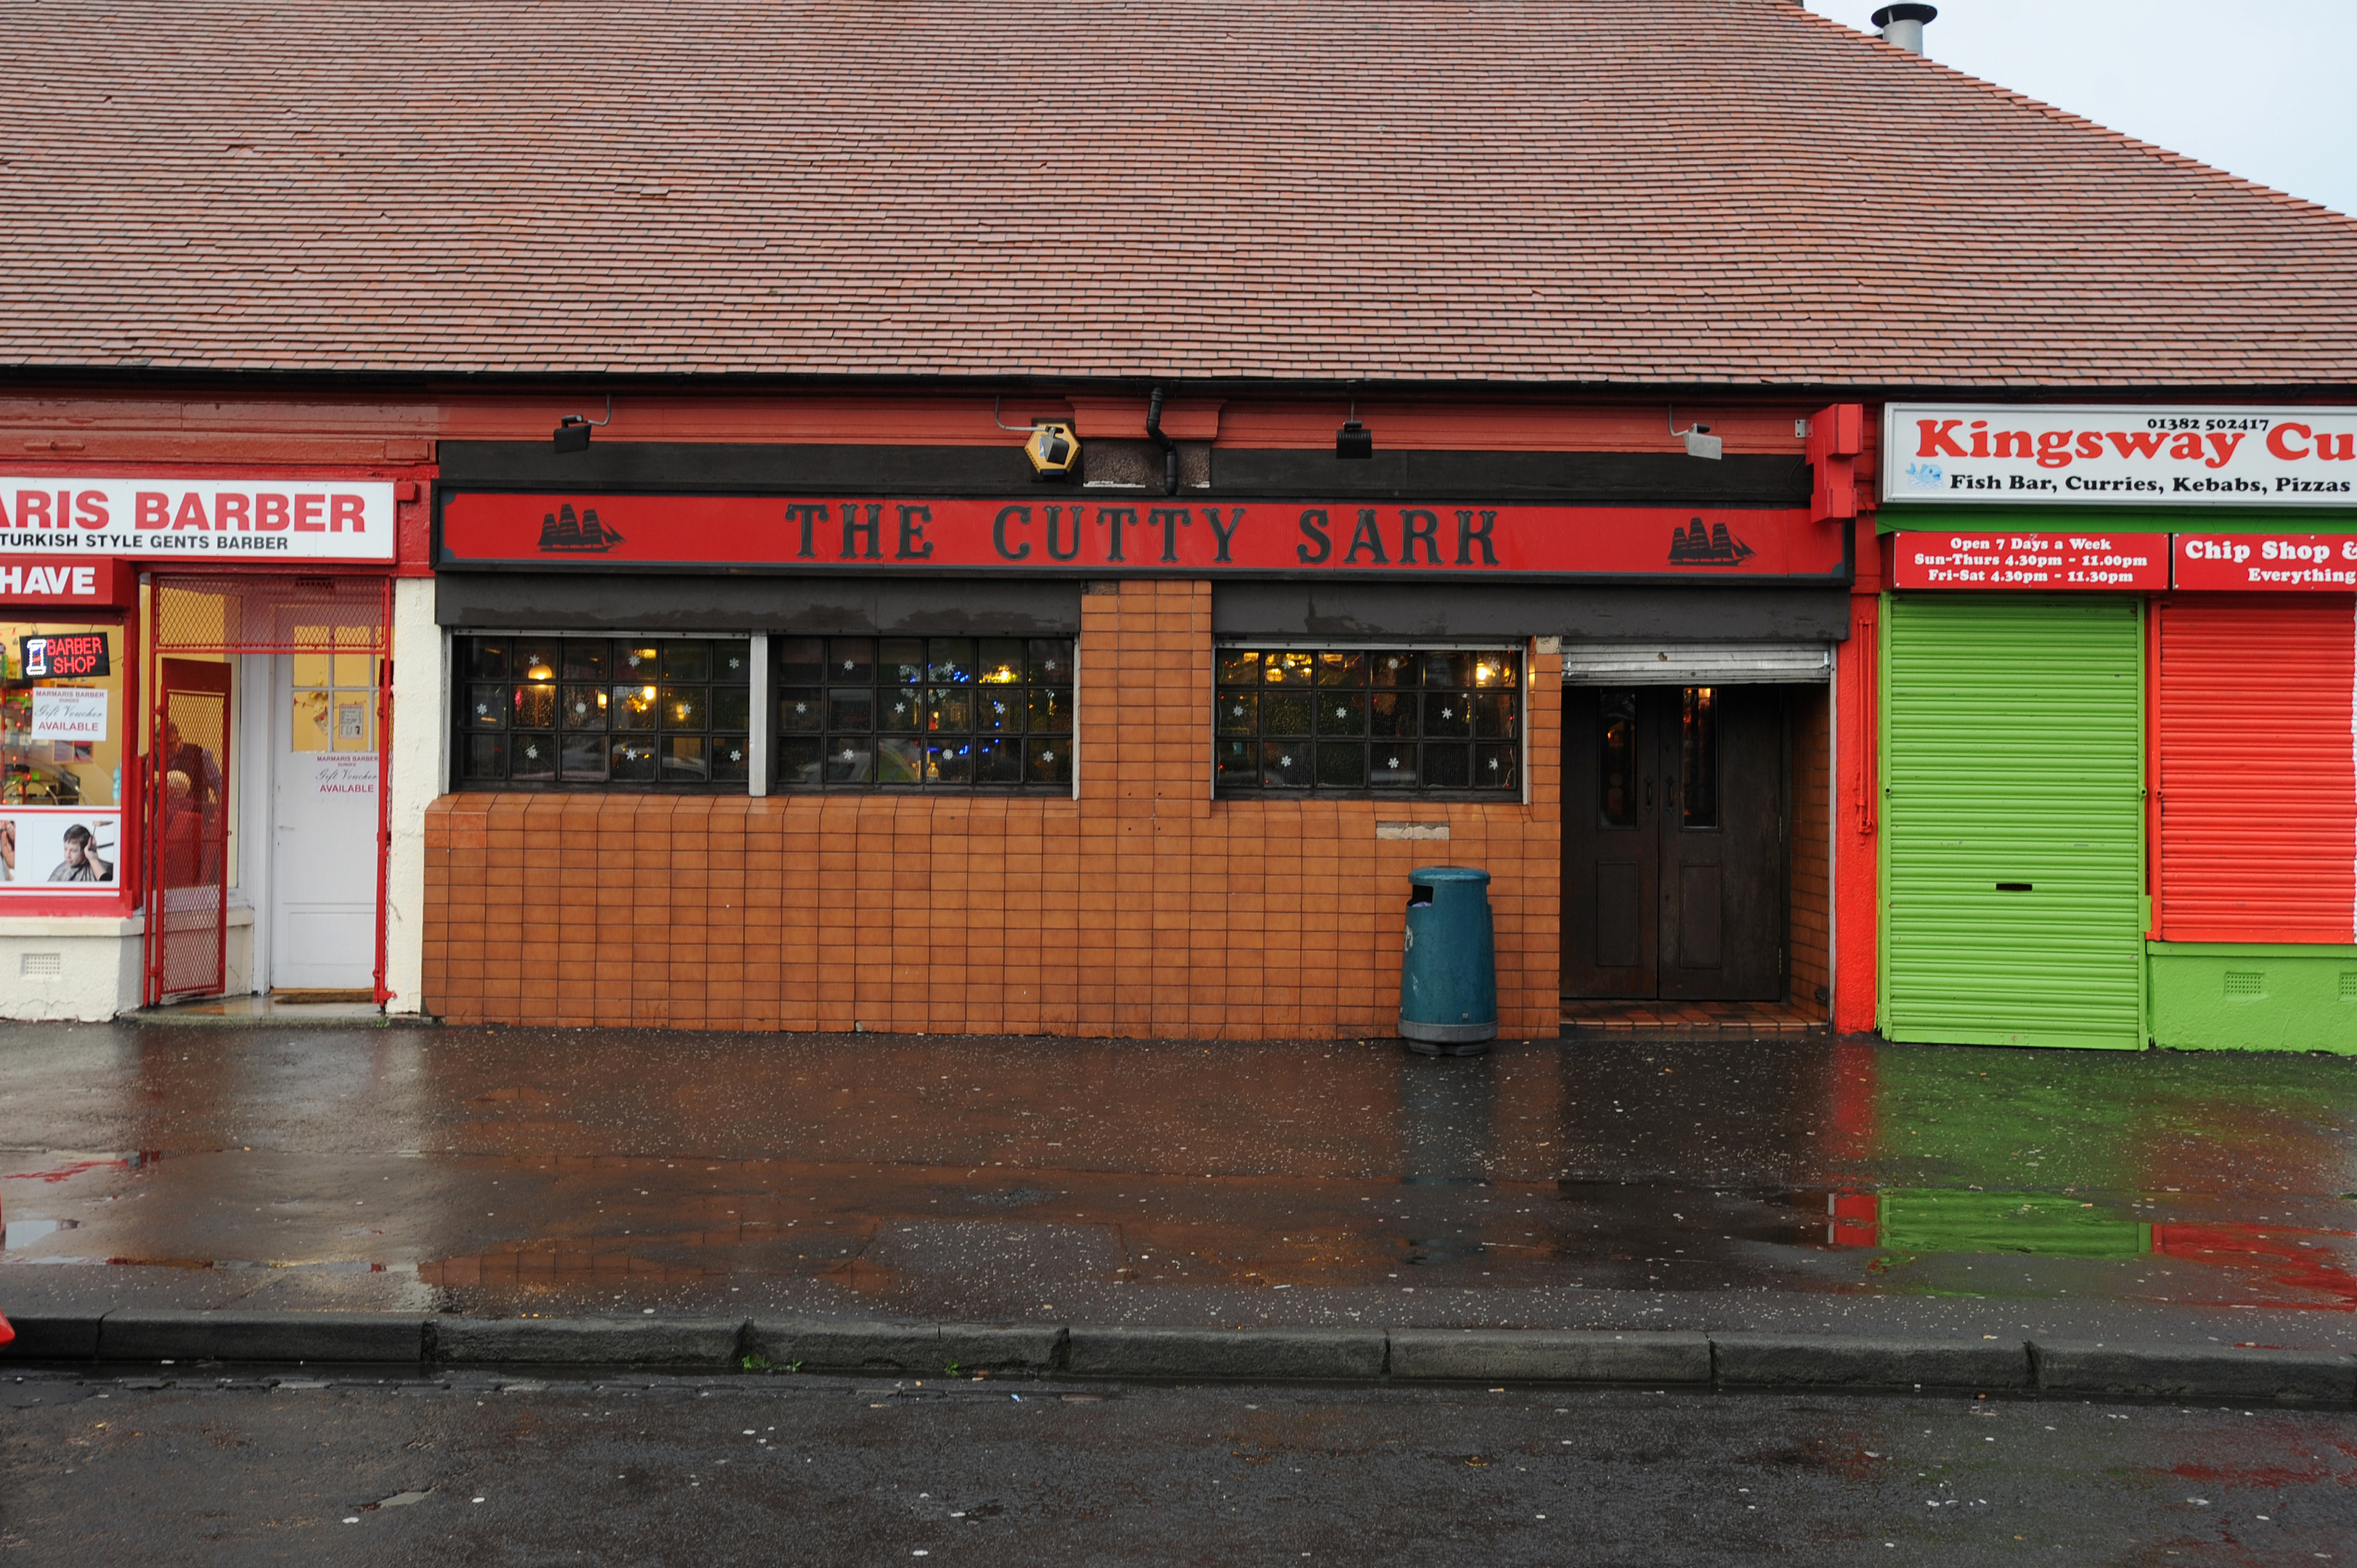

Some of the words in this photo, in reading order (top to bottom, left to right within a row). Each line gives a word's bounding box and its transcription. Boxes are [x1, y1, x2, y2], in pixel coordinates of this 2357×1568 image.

[2147, 419, 2200, 430] 01382
[2205, 419, 2270, 432] 502417
[1915, 420, 2246, 468] Kingsway
[2266, 422, 2356, 461] Cu
[1950, 475, 2000, 490] Fish
[2009, 475, 2058, 494] Bar,
[2065, 476, 2164, 495] Curries,
[2173, 477, 2268, 496] Kebabs,
[2276, 478, 2351, 492] Pizzas
[0, 490, 110, 530] RIS
[135, 492, 366, 533] BARBER
[0, 534, 78, 547] TURKISH
[86, 535, 143, 548] STYLE
[150, 536, 210, 550] GENTS
[217, 536, 288, 550] BARBER
[785, 502, 935, 560] THE
[991, 505, 1247, 563] CUTTY
[1296, 507, 1501, 566] SARK
[1950, 538, 1990, 552] Open
[1996, 539, 2006, 550] 7
[2011, 538, 2049, 552] Days
[2054, 541, 2064, 550] a
[2069, 538, 2112, 551] Week
[2185, 540, 2252, 563] Chip
[2261, 540, 2332, 564] Shop
[1914, 553, 2000, 565] Sun-Thurs
[2005, 555, 2063, 568] 4.30pm
[2082, 555, 2149, 568] 11.00pm
[0, 565, 96, 595] HAVE
[1929, 569, 1986, 582] Fri-Sat
[1990, 571, 2049, 584] 4.30pm
[2067, 571, 2135, 584] 11.30pm
[2248, 568, 2357, 586] Everything
[46, 637, 102, 656] BARBER
[53, 656, 97, 674] SHOP
[35, 704, 60, 720] Gift
[63, 705, 103, 718] Voucher
[38, 721, 99, 732] AVAILABLE
[315, 769, 338, 783] Gift
[341, 769, 377, 780] Voucher
[319, 784, 374, 793] AVAILABLE
